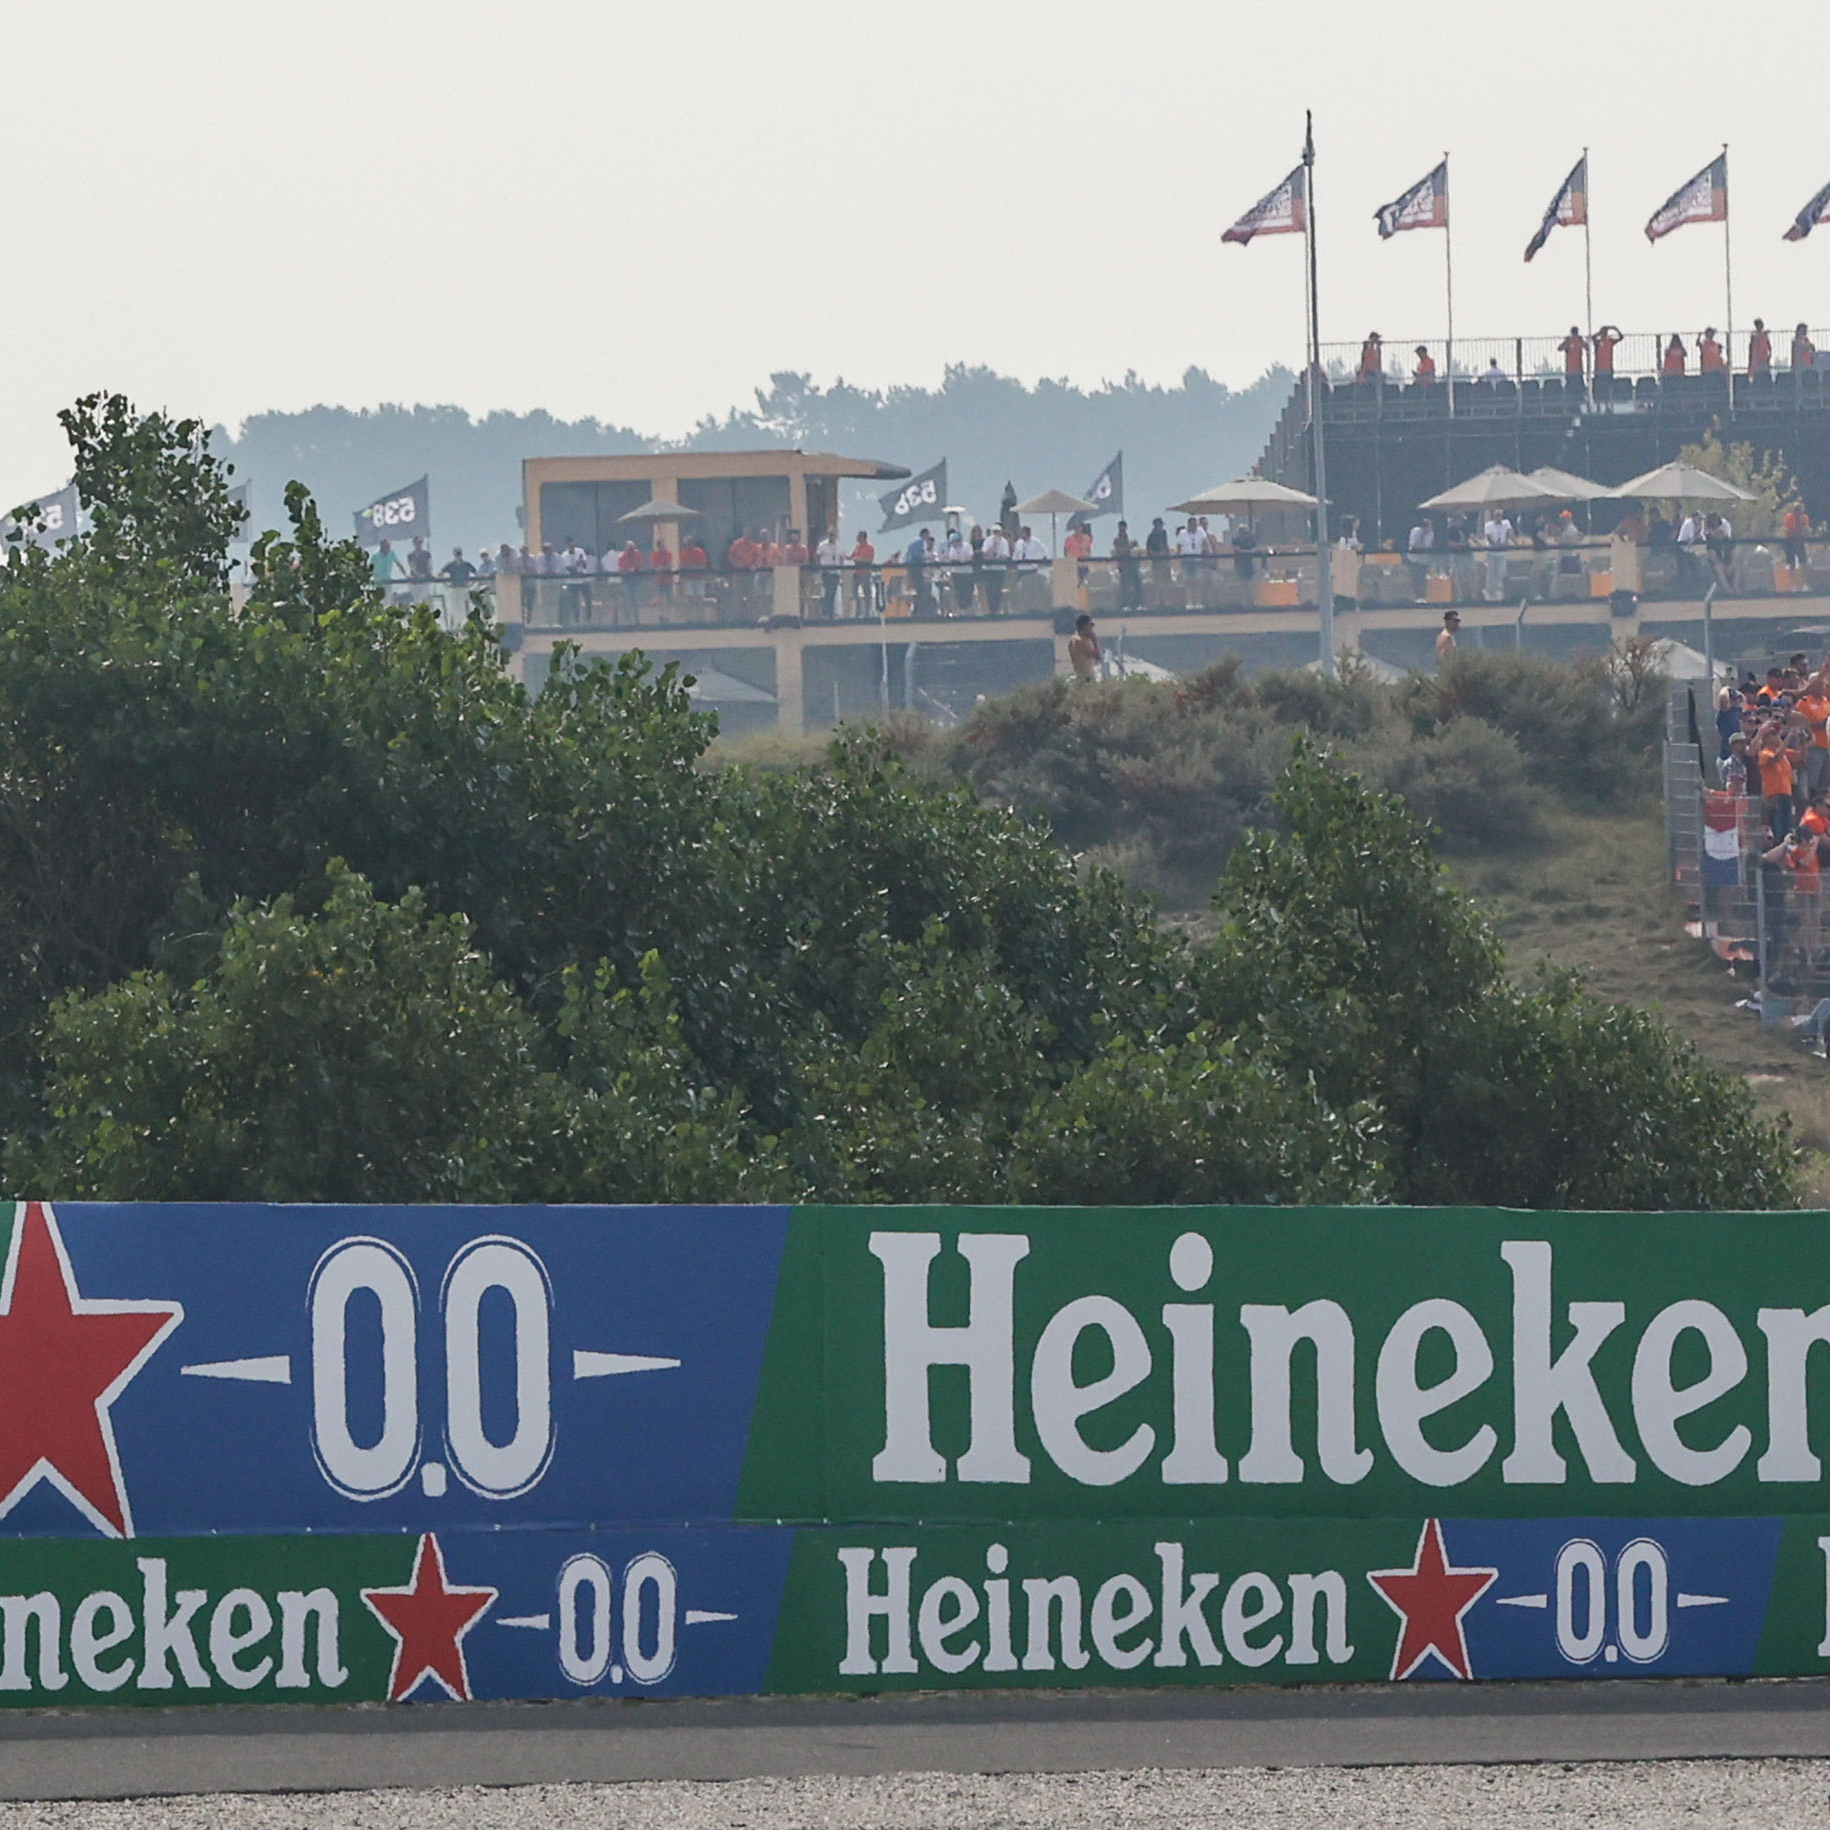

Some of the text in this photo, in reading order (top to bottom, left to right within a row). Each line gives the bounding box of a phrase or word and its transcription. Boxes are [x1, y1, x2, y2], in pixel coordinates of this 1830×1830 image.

[310, 1238, 553, 1499] 0.0
[558, 1553, 677, 1684] 0.0
[838, 1542, 1354, 1674] Heineken
[1556, 1539, 1669, 1662] 0.0
